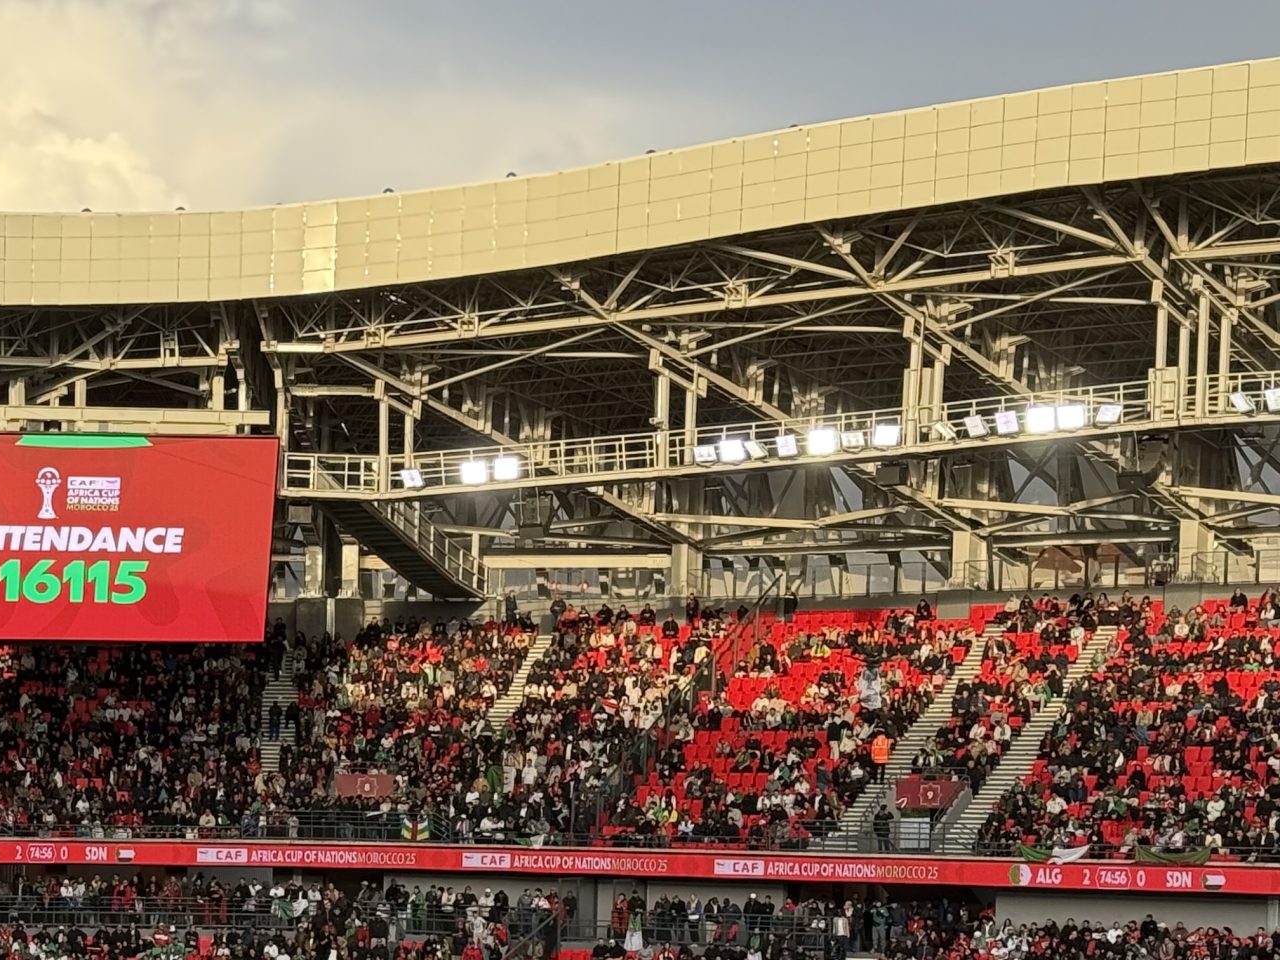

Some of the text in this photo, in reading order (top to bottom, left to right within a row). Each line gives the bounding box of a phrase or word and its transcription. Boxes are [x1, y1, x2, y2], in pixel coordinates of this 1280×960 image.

[66, 496, 120, 505] OF NATIONS
[67, 489, 120, 497] AFRICA CUP
[364, 783, 370, 791] 8
[926, 791, 934, 799] 9
[15, 845, 22, 860] 2
[30, 846, 53, 858] 74:56
[60, 846, 68, 860] 0
[85, 846, 107, 860] SDN
[215, 850, 416, 865] CAF AFRICA CUP OF NATIONS MOROCCO 25
[480, 855, 667, 872] CAF AFRICA CUP OF NATIONS MOROCCO 25
[733, 862, 938, 879] CAF AFRICA CUP OF NATIONS MOROCCO 25
[1036, 868, 1192, 887] ALG 2 74:56 0 SDN
